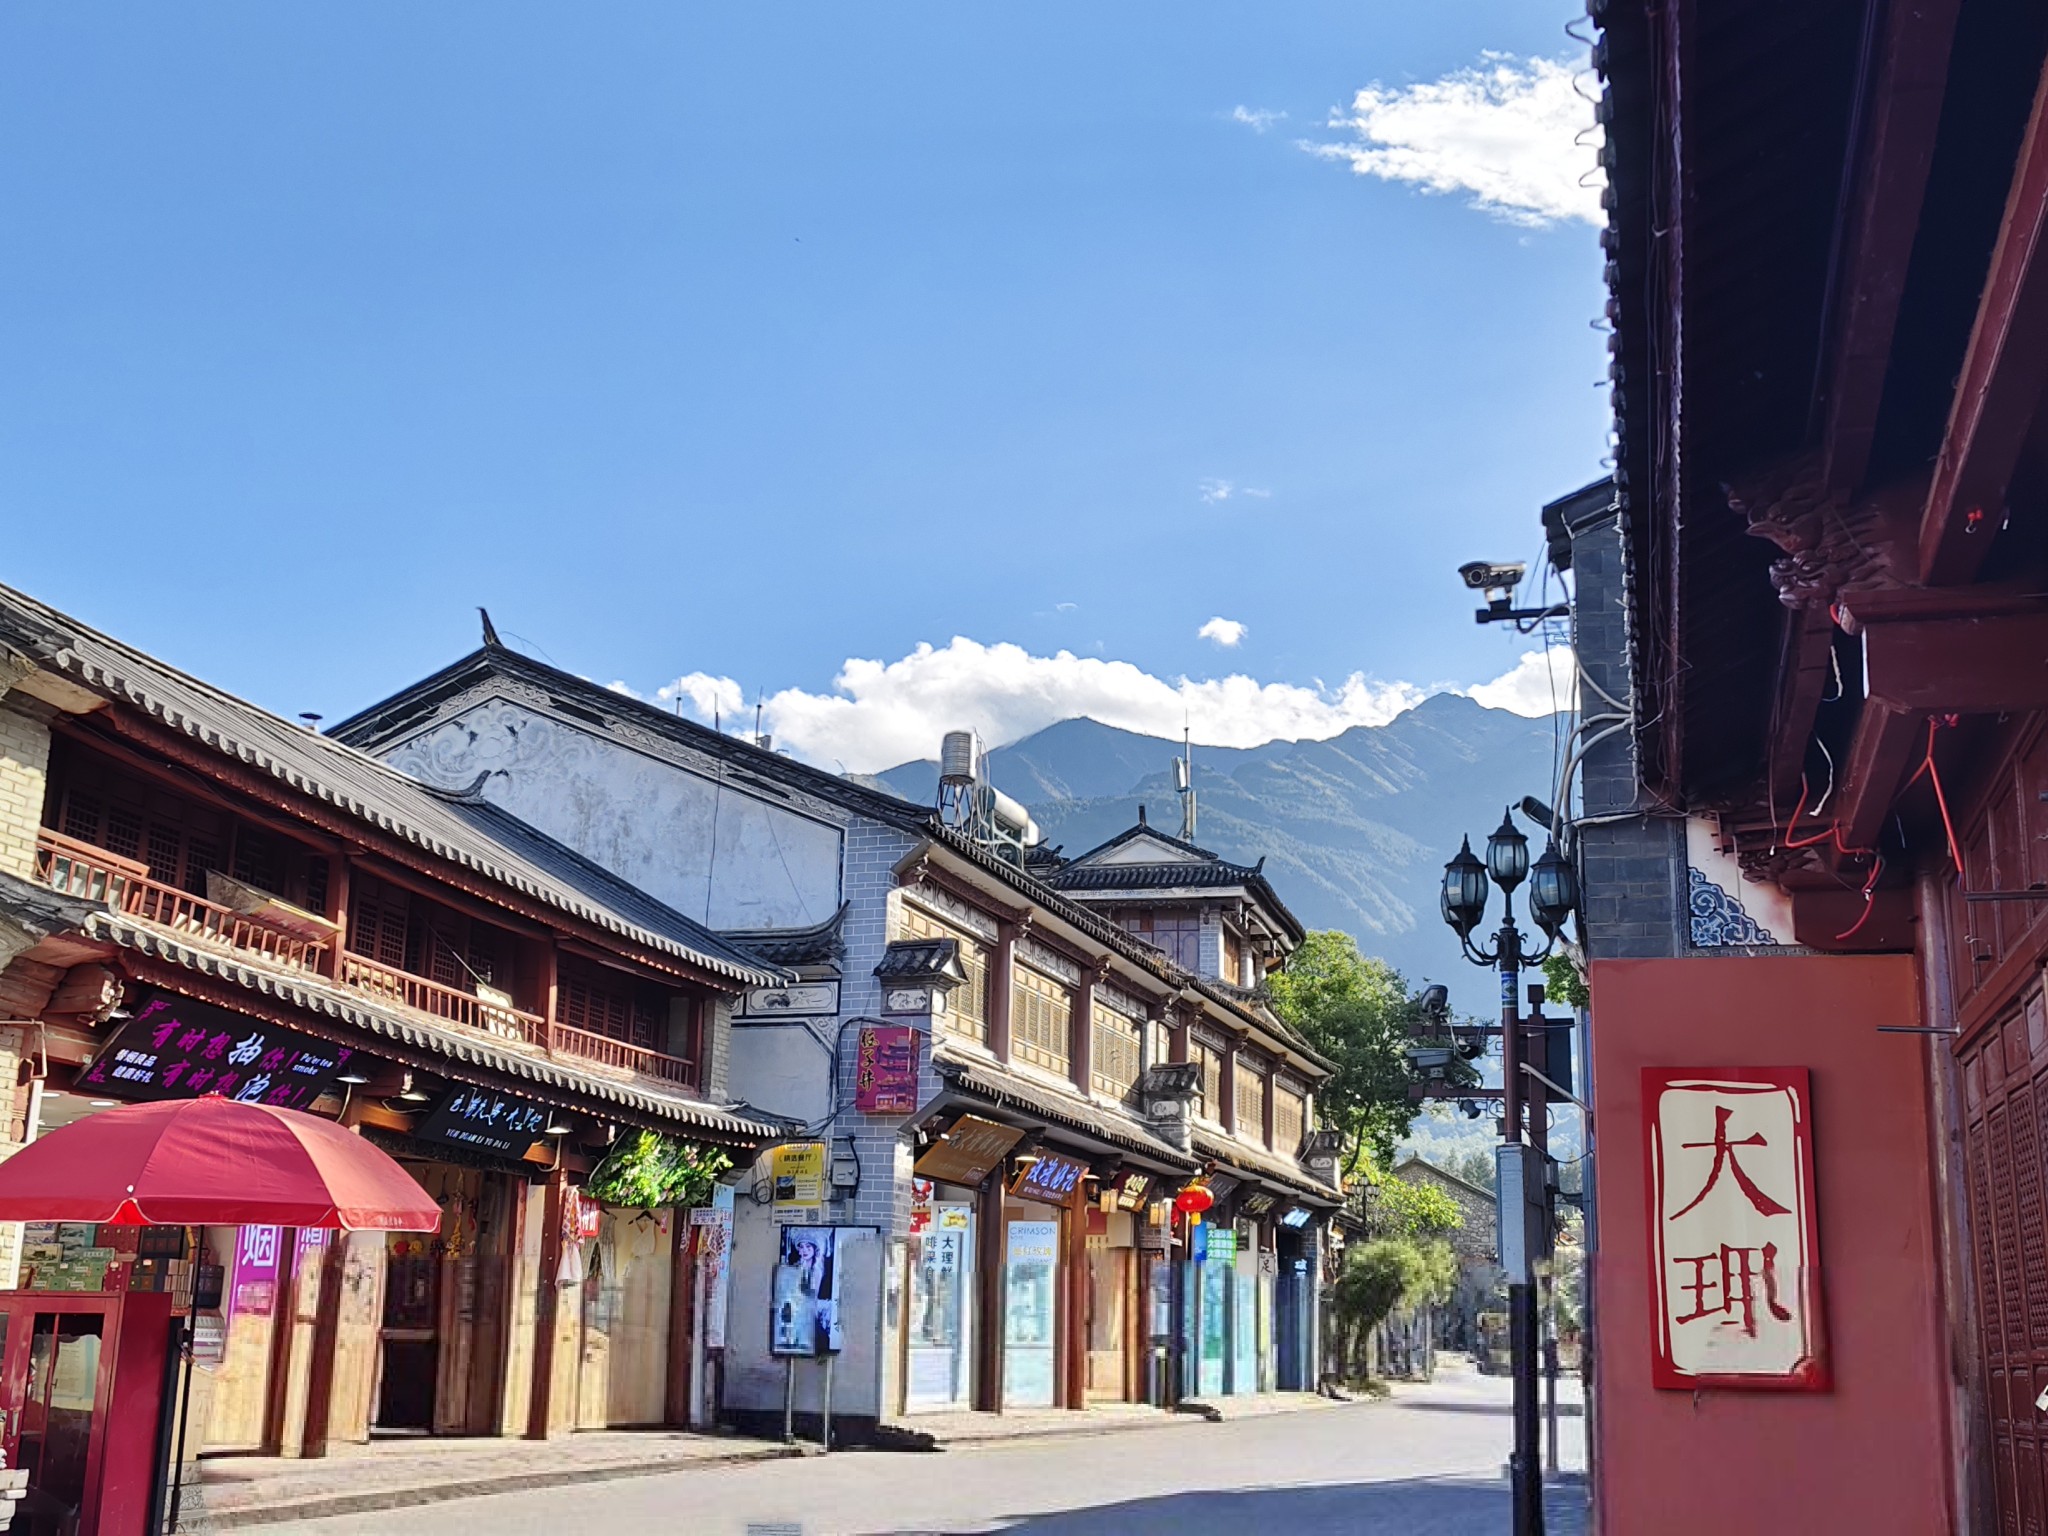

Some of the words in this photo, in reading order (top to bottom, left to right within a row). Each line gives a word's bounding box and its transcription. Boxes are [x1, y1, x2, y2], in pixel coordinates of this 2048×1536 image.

[292, 1064, 318, 1076] smoke
[1668, 1105, 1793, 1338] 大理
[1009, 1226, 1056, 1236] CRIMSON
